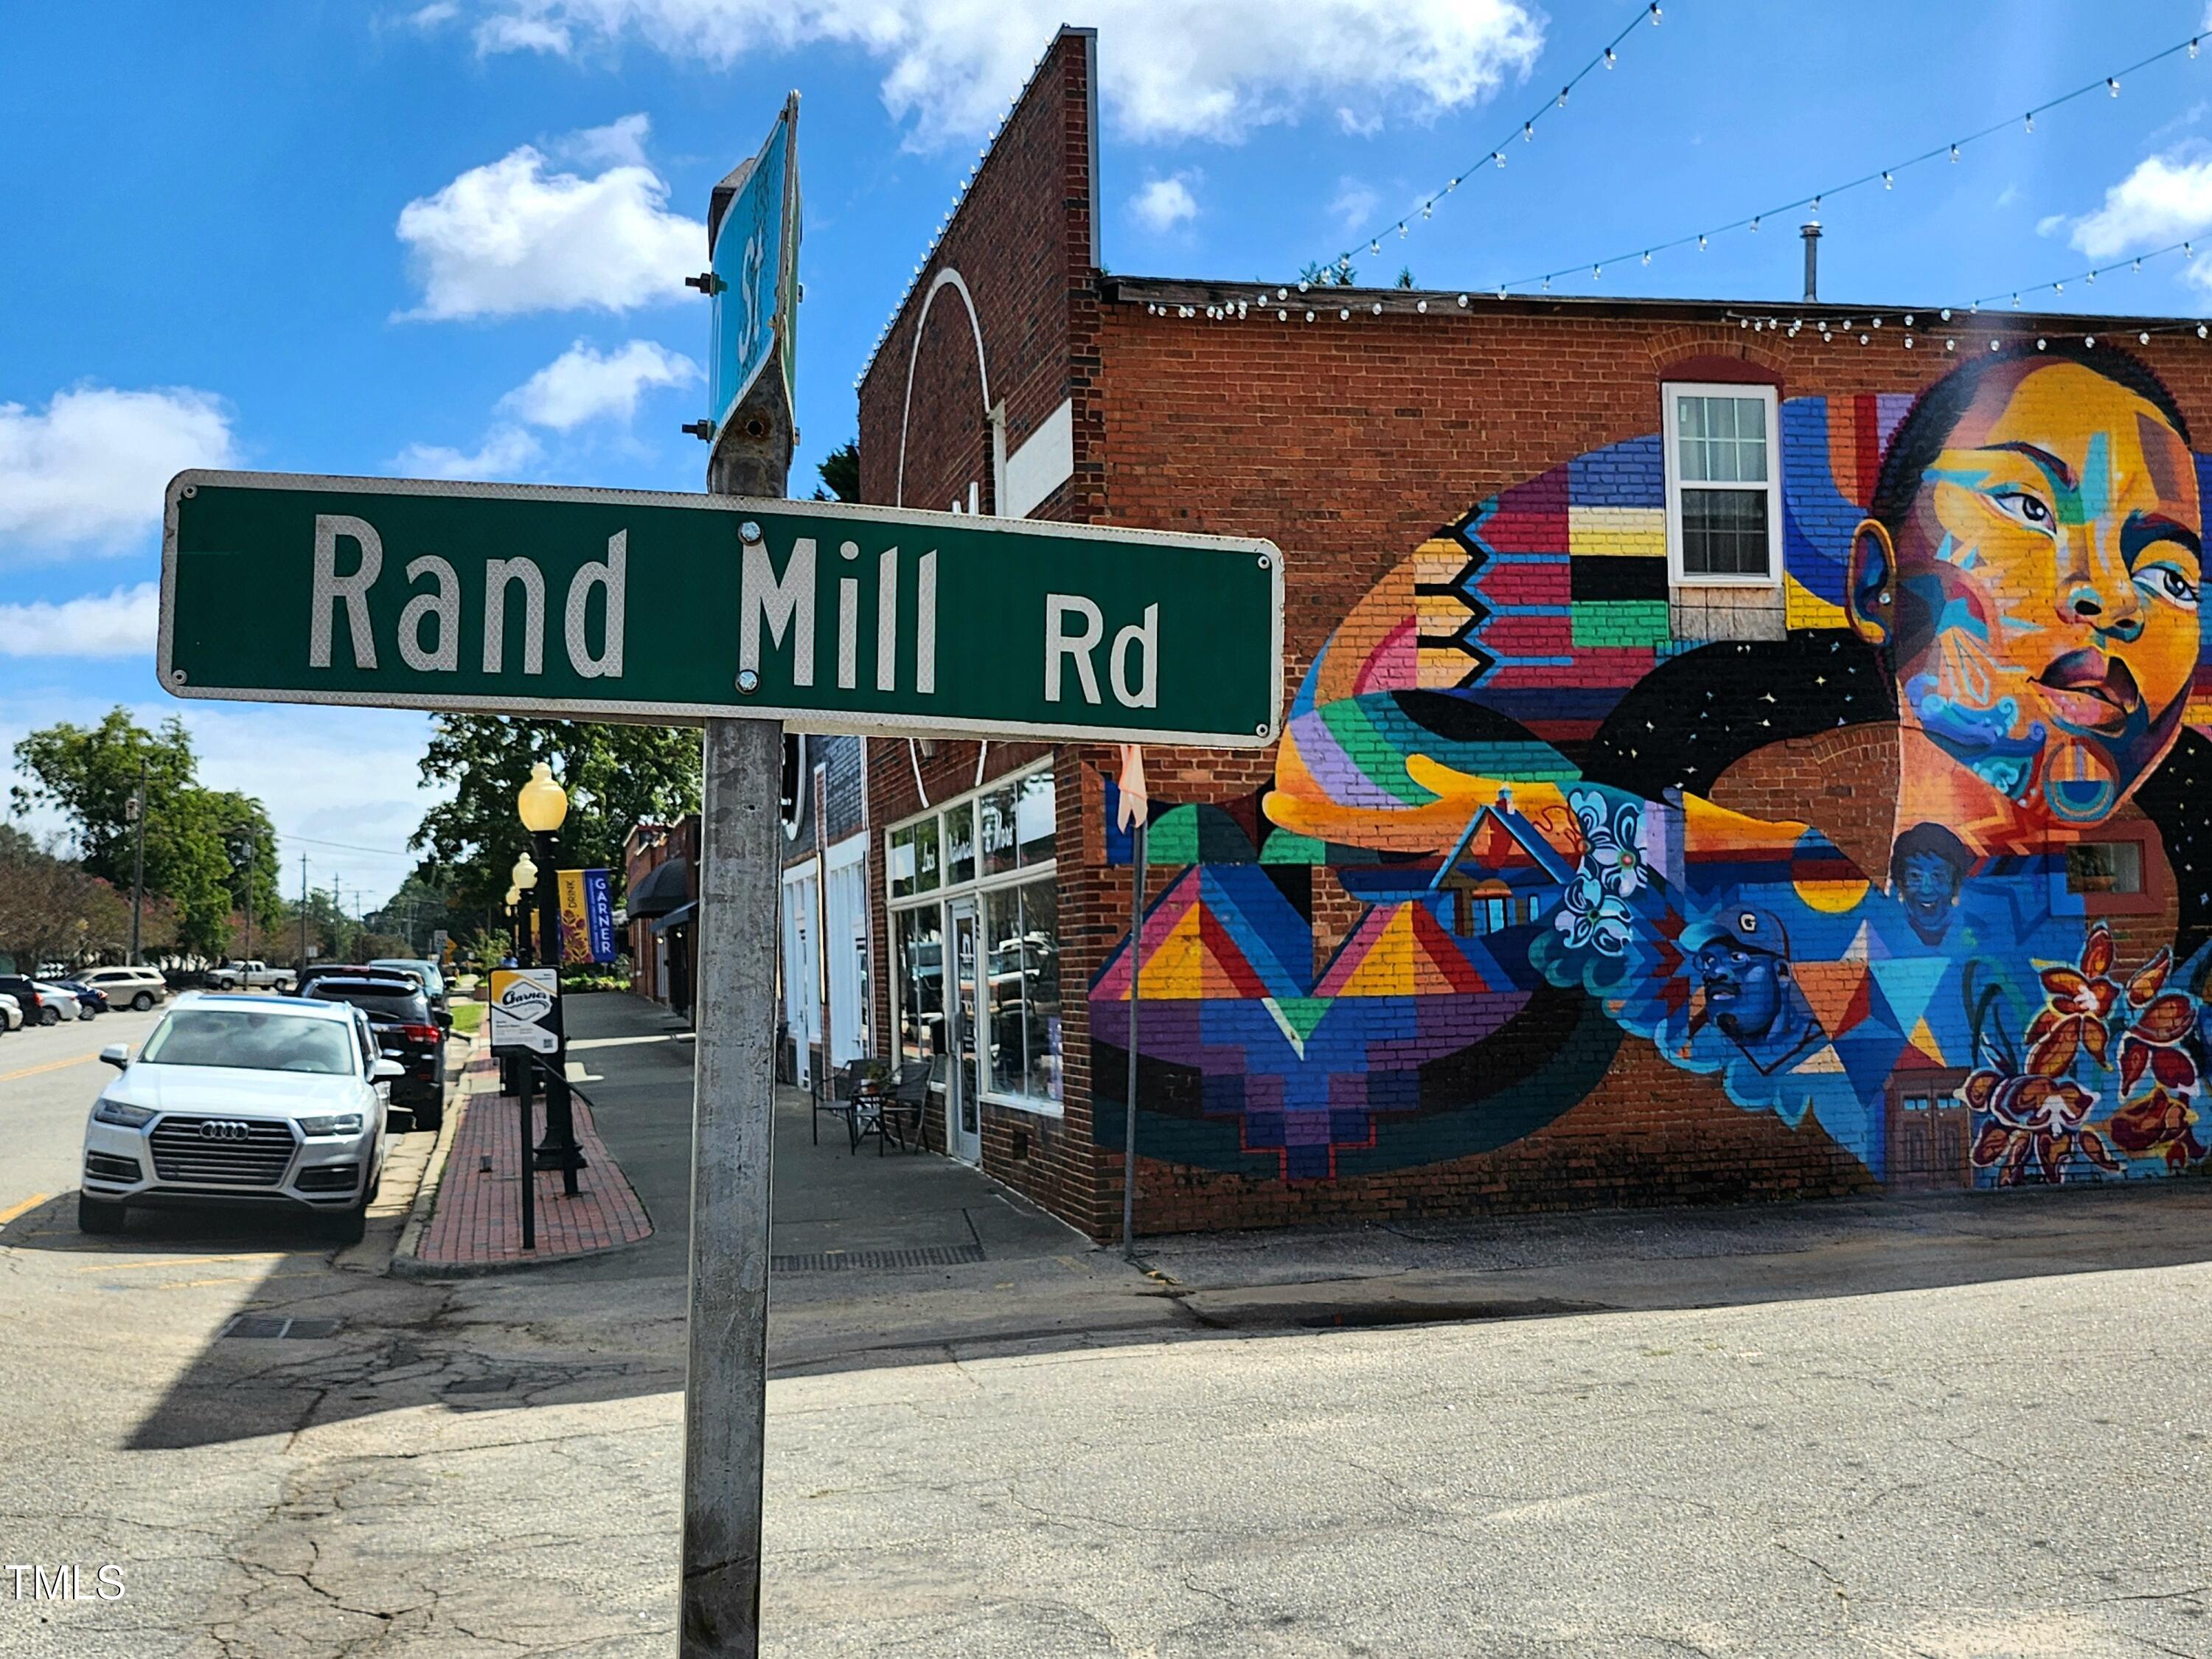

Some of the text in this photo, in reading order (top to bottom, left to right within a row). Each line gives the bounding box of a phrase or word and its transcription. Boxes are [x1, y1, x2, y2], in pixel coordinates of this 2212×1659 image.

[738, 221, 764, 364] St
[309, 514, 1158, 709] Rand Mill Rd
[566, 880, 577, 908] DRINK
[594, 877, 612, 953] GARNER
[1740, 914, 1756, 931] G
[502, 990, 547, 1006] Garner
